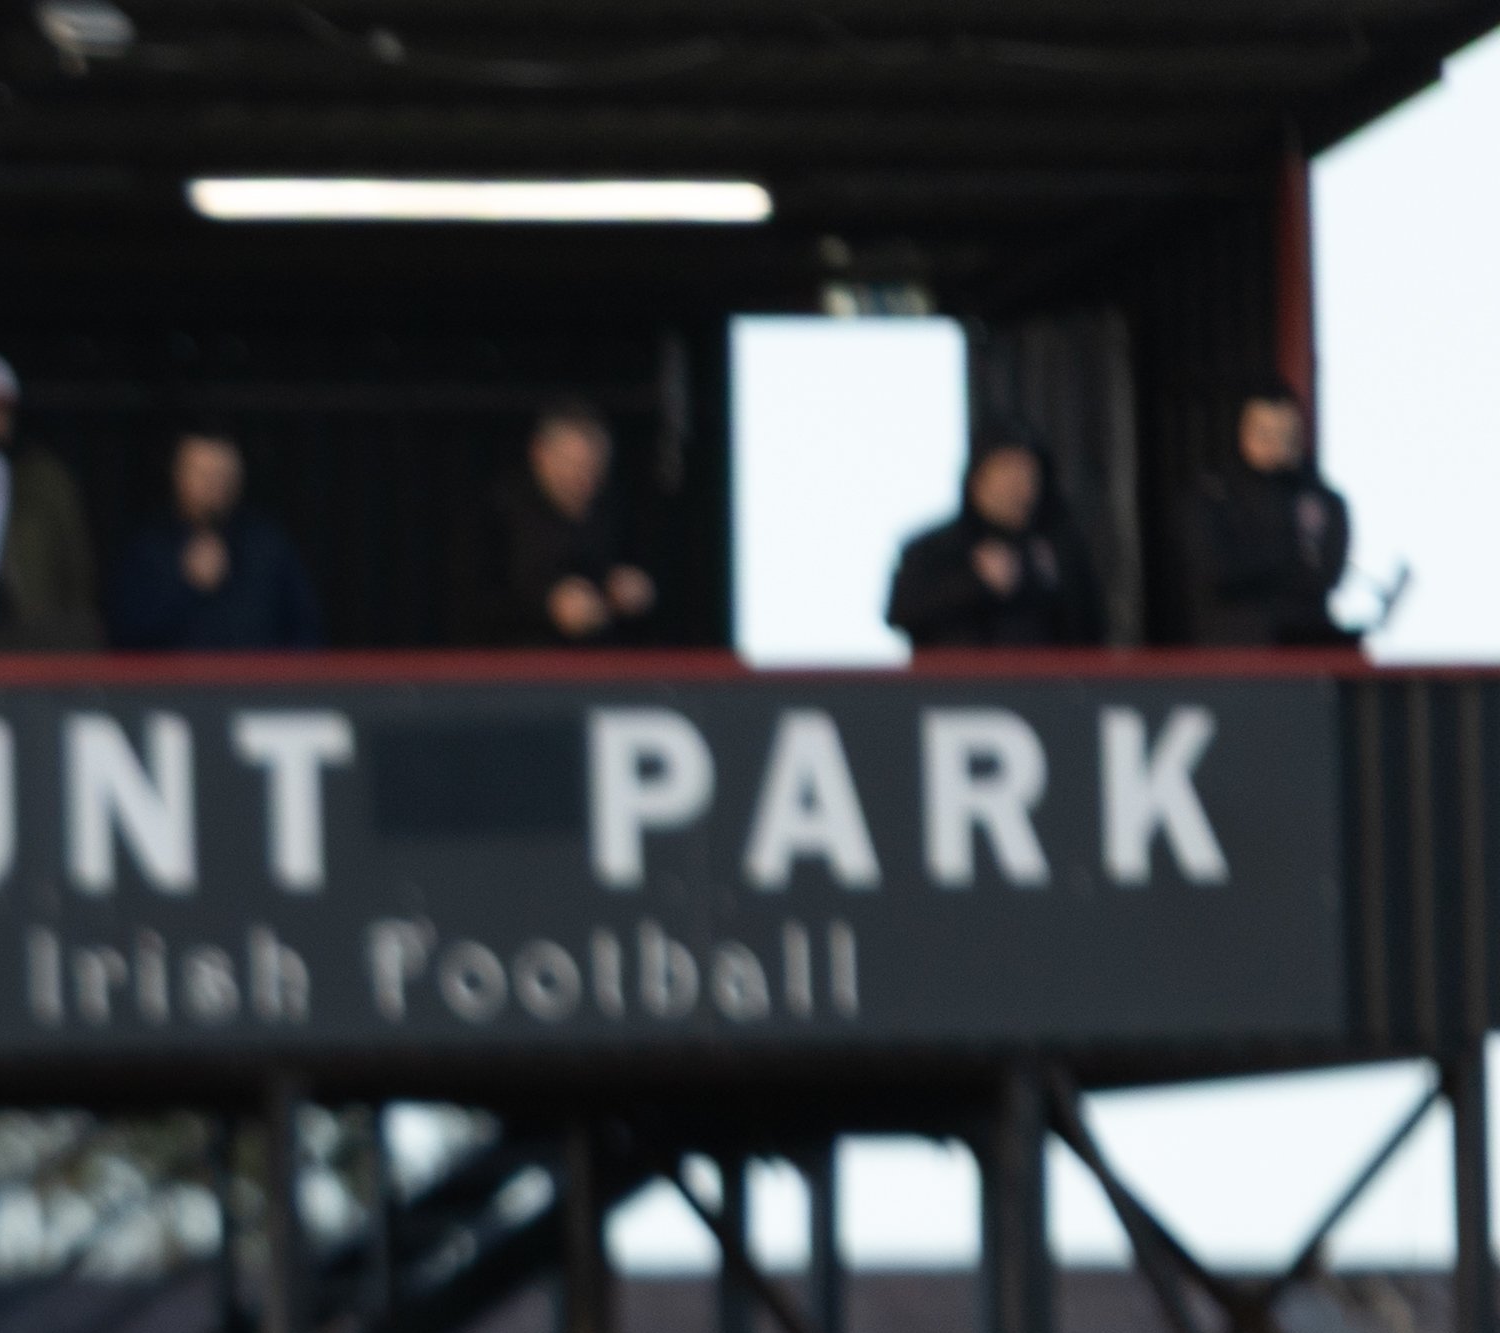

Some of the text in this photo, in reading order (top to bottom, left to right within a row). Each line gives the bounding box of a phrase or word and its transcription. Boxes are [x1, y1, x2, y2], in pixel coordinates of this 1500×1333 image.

[586, 706, 1230, 889] PARK
[25, 920, 312, 1029] Irish
[365, 918, 862, 1023] Football
